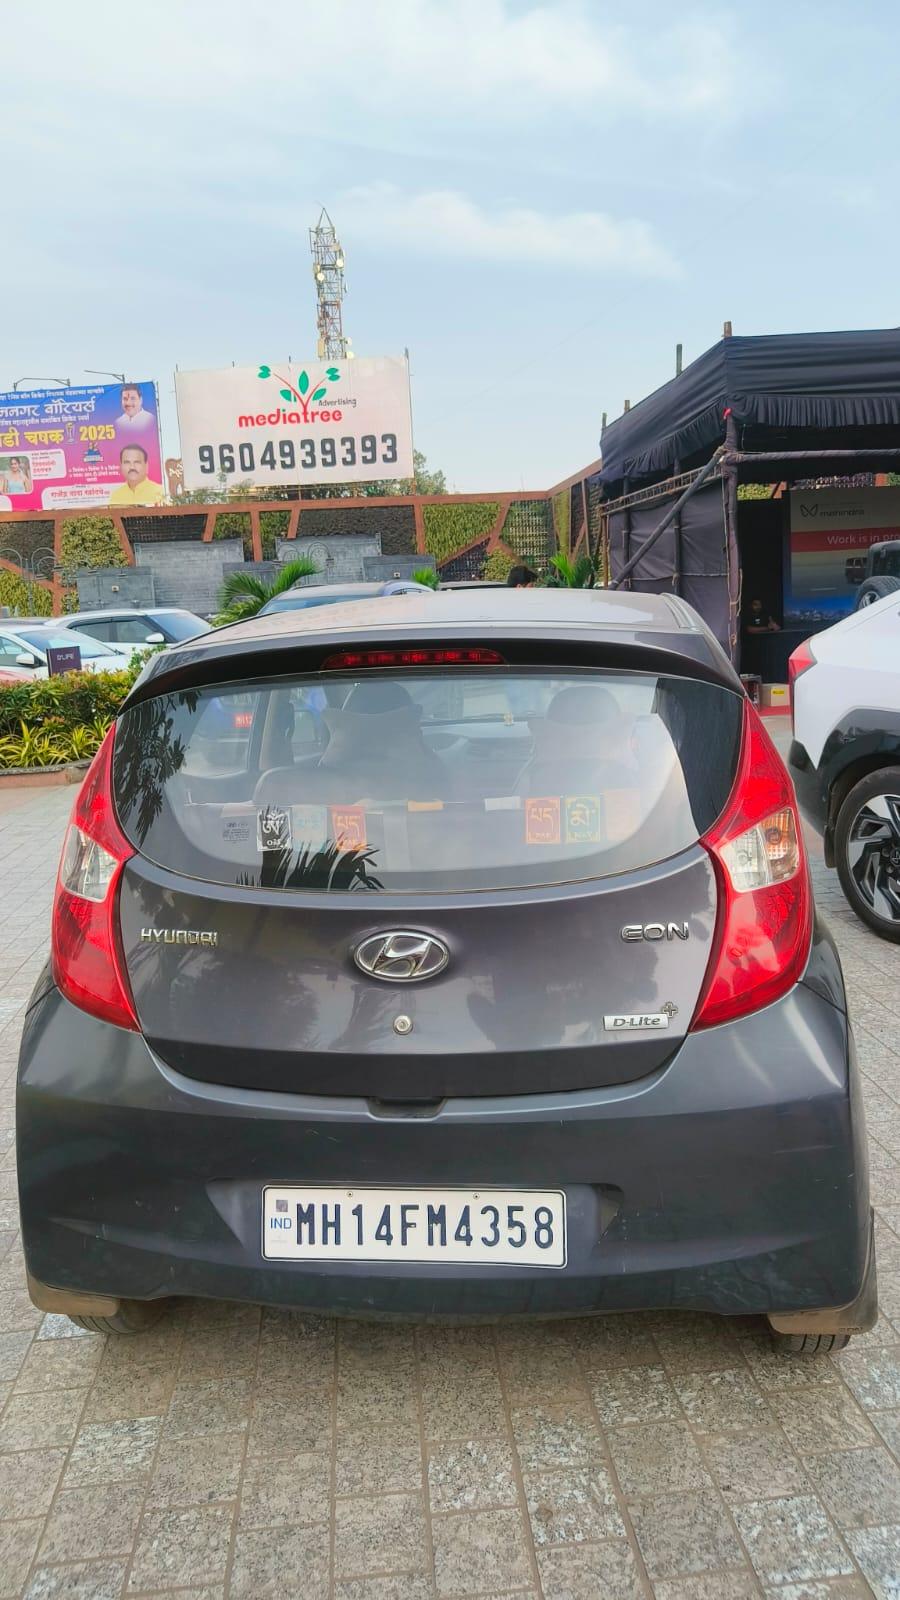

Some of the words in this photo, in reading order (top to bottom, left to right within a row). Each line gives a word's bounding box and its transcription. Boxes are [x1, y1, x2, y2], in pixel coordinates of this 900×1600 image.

[318, 398, 357, 408] Advertising
[238, 406, 342, 428] mediatree
[24, 430, 64, 445] चषक
[80, 425, 115, 441] 2025
[198, 433, 398, 474] 9604939393
[827, 535, 857, 546] Work
[859, 535, 868, 544] is
[870, 534, 880, 544] in
[141, 928, 218, 945] HYUNDAI
[621, 921, 690, 943] EON
[270, 1217, 292, 1230] IND
[296, 1203, 554, 1250] MH14FM4358
